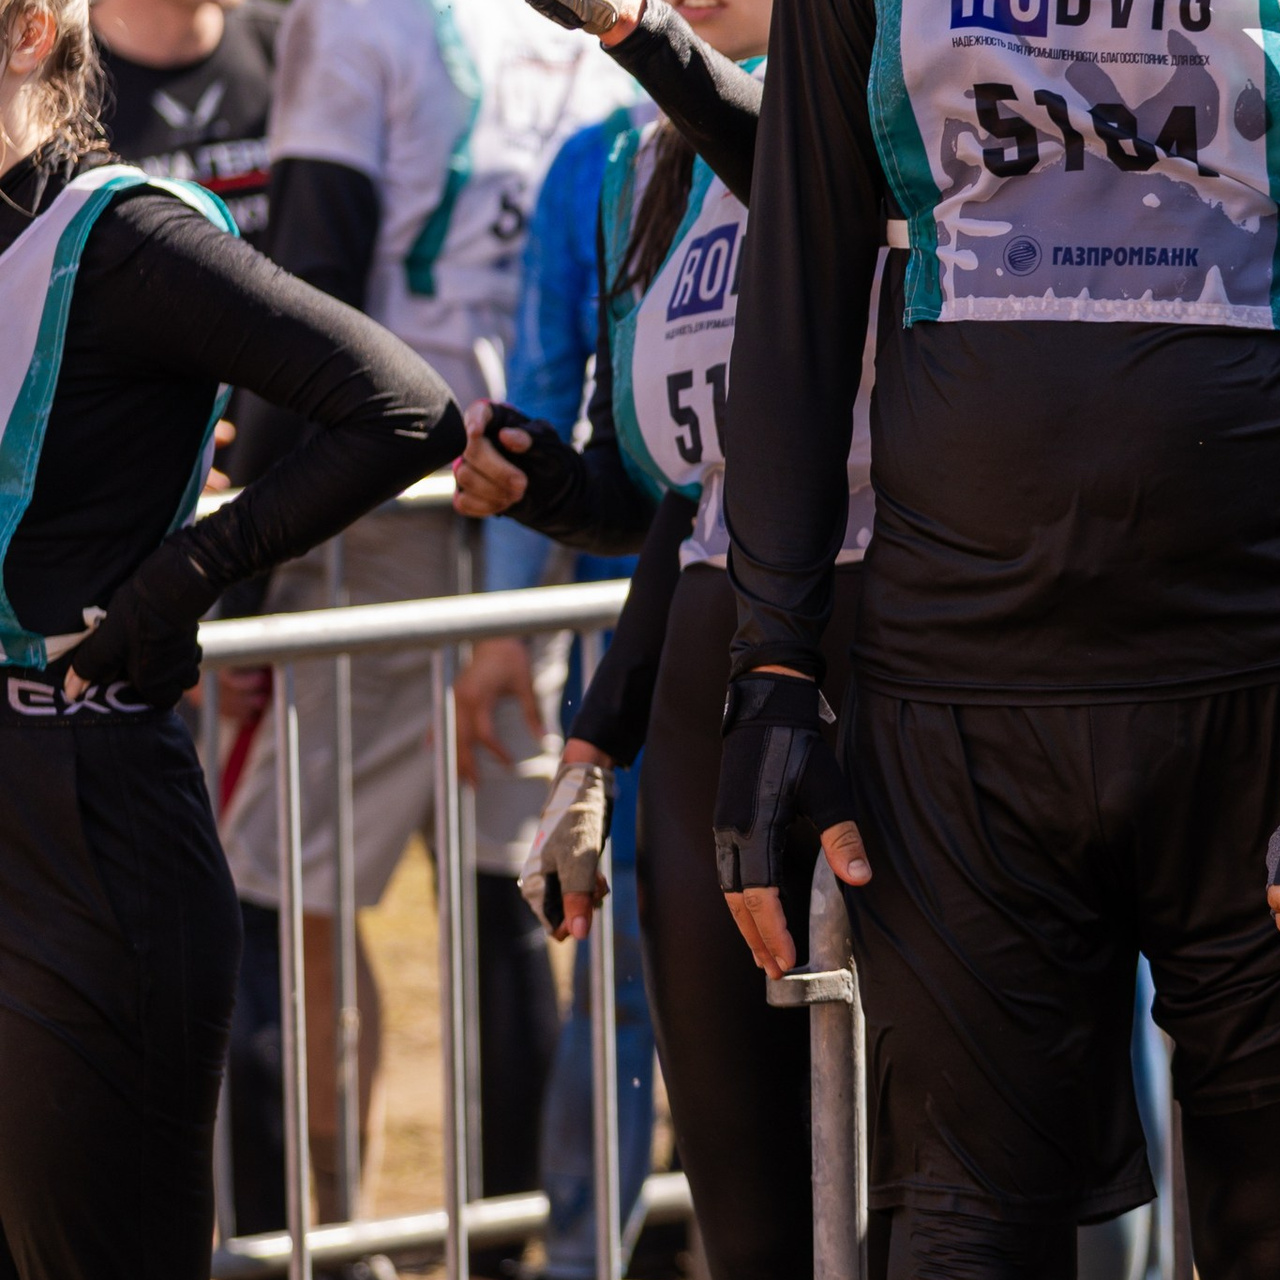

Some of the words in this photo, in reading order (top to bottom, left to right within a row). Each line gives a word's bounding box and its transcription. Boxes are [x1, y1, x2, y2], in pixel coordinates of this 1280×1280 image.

[951, 35, 1007, 49] НАДЕЖНОСТЬ
[1007, 42, 1024, 56] ДЛЯ
[1100, 53, 1169, 66] БЛАГОСОСТОЯНИЕ
[1170, 55, 1188, 67] ДЛЯ
[1189, 54, 1211, 66] ВСЕХ
[1052, 245, 1199, 267] ГАЗПРОМБАНК
